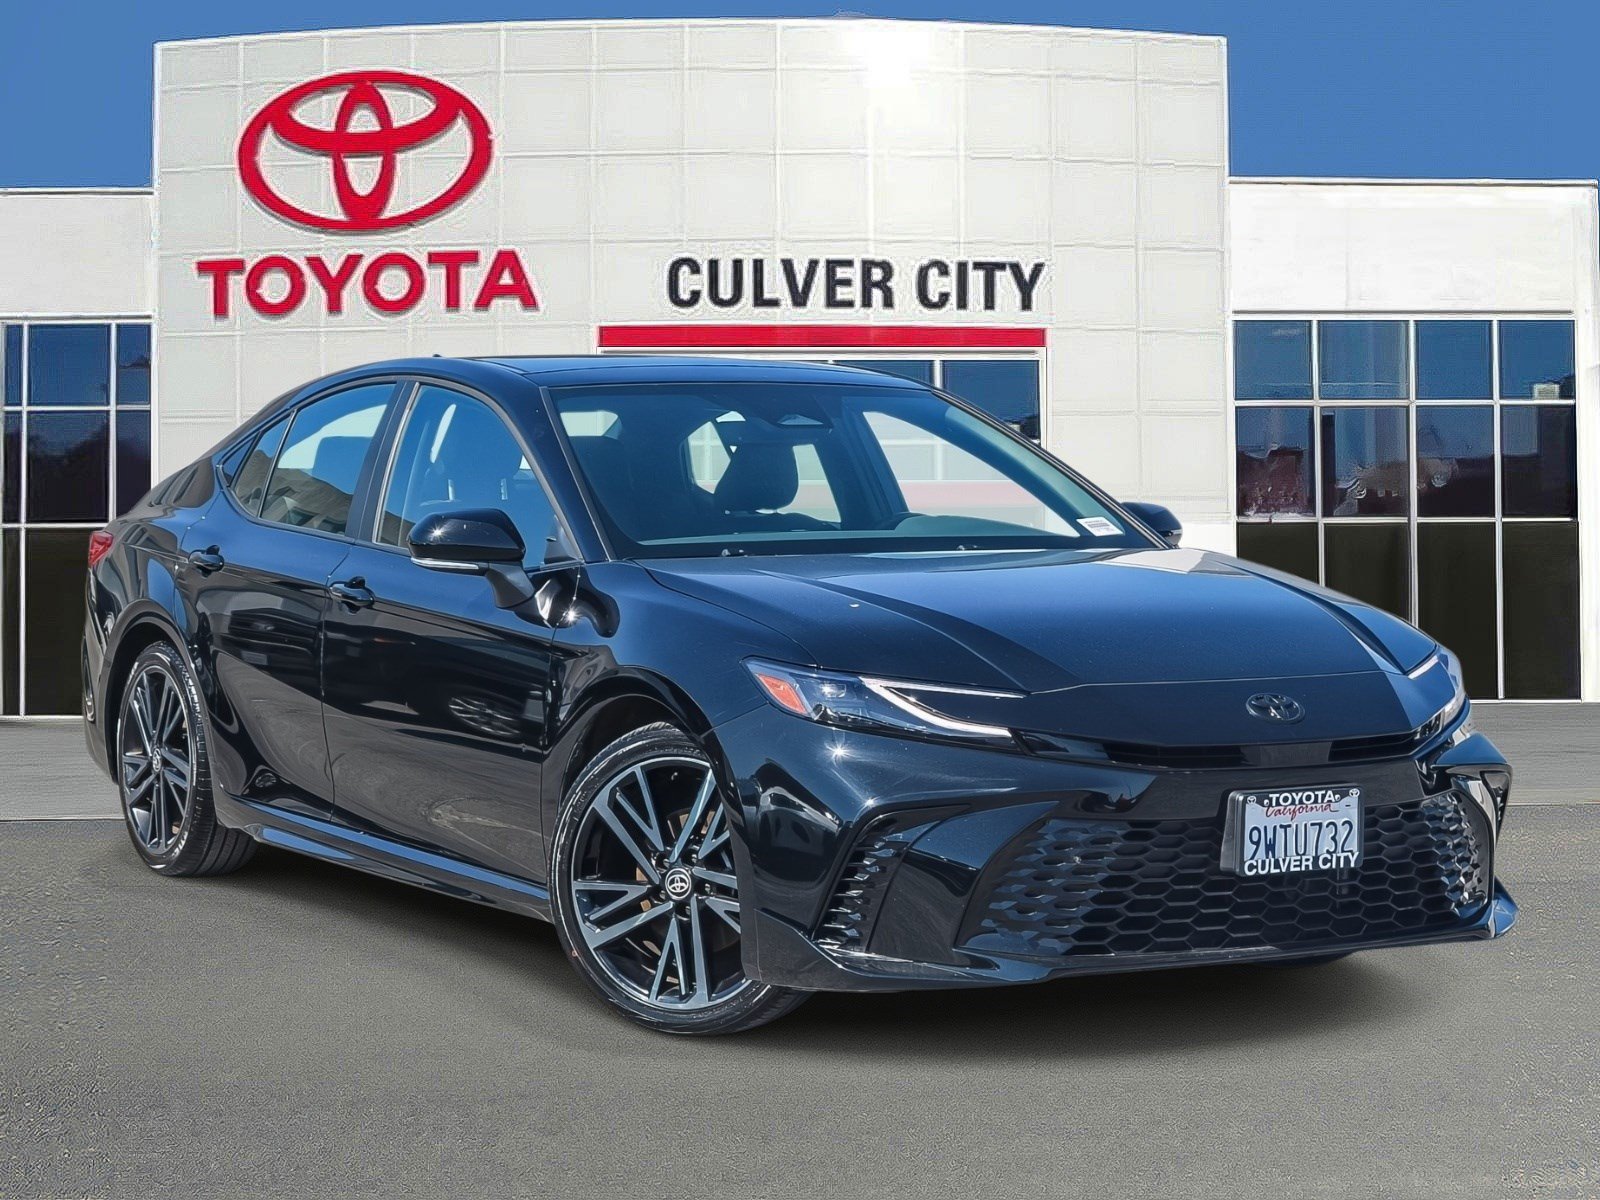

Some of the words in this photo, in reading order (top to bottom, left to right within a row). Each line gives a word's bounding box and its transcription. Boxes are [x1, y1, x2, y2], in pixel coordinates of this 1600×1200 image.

[196, 250, 540, 318] TOYOTA
[668, 258, 893, 310] CULVER
[916, 258, 1046, 312] CITY
[1266, 803, 1339, 821] California
[1269, 790, 1335, 806] TOYOTA
[1249, 820, 1353, 860] 9WTU732
[1244, 857, 1313, 876] CULVER
[1318, 852, 1359, 870] CITY
